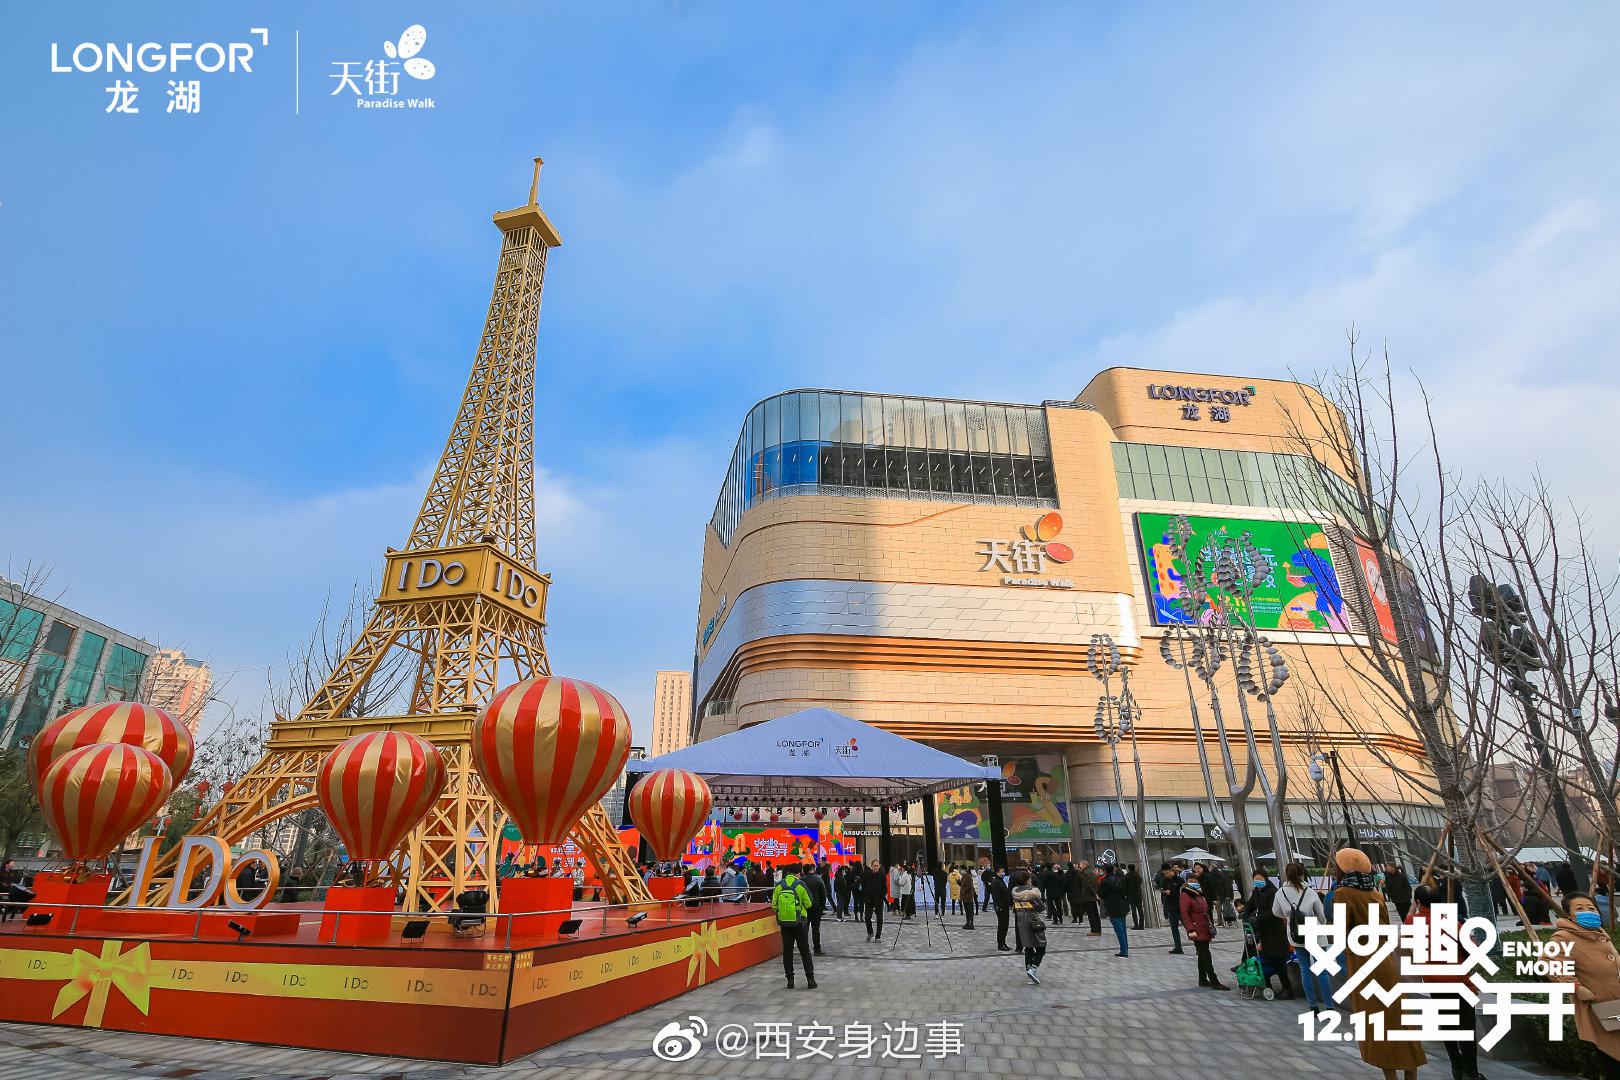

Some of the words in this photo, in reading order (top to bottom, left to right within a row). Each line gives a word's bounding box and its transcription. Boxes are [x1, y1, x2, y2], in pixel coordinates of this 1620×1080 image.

[1147, 384, 1251, 406] LONGFOR
[975, 539, 1046, 574] 天街
[397, 561, 412, 591] I
[494, 561, 504, 592] I
[776, 740, 821, 749] LONGFOR
[1359, 828, 1398, 838] HUAWEI
[128, 835, 165, 908] I
